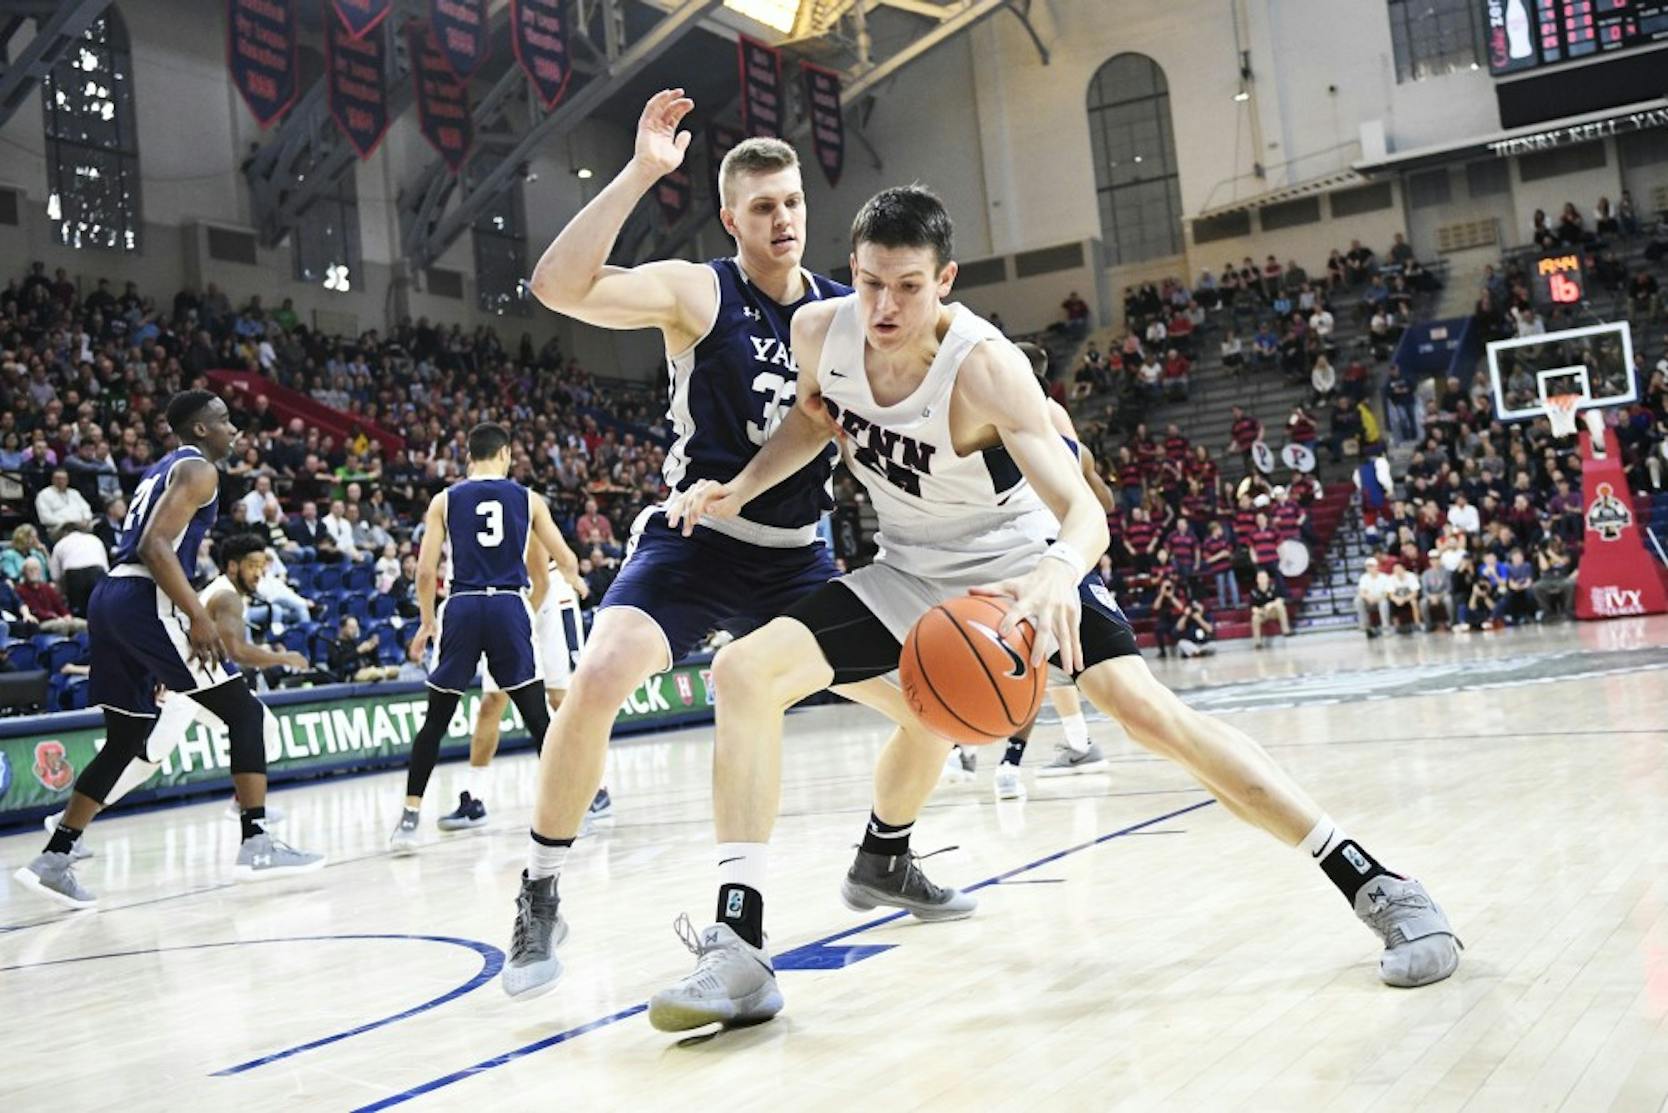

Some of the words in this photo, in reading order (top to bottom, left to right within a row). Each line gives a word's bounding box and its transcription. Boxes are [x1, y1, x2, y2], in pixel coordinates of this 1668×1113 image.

[1550, 274, 1579, 301] 16
[750, 335, 799, 372] YAL
[475, 500, 504, 548] 3
[1605, 589, 1642, 609] IVY
[619, 674, 671, 716] CK
